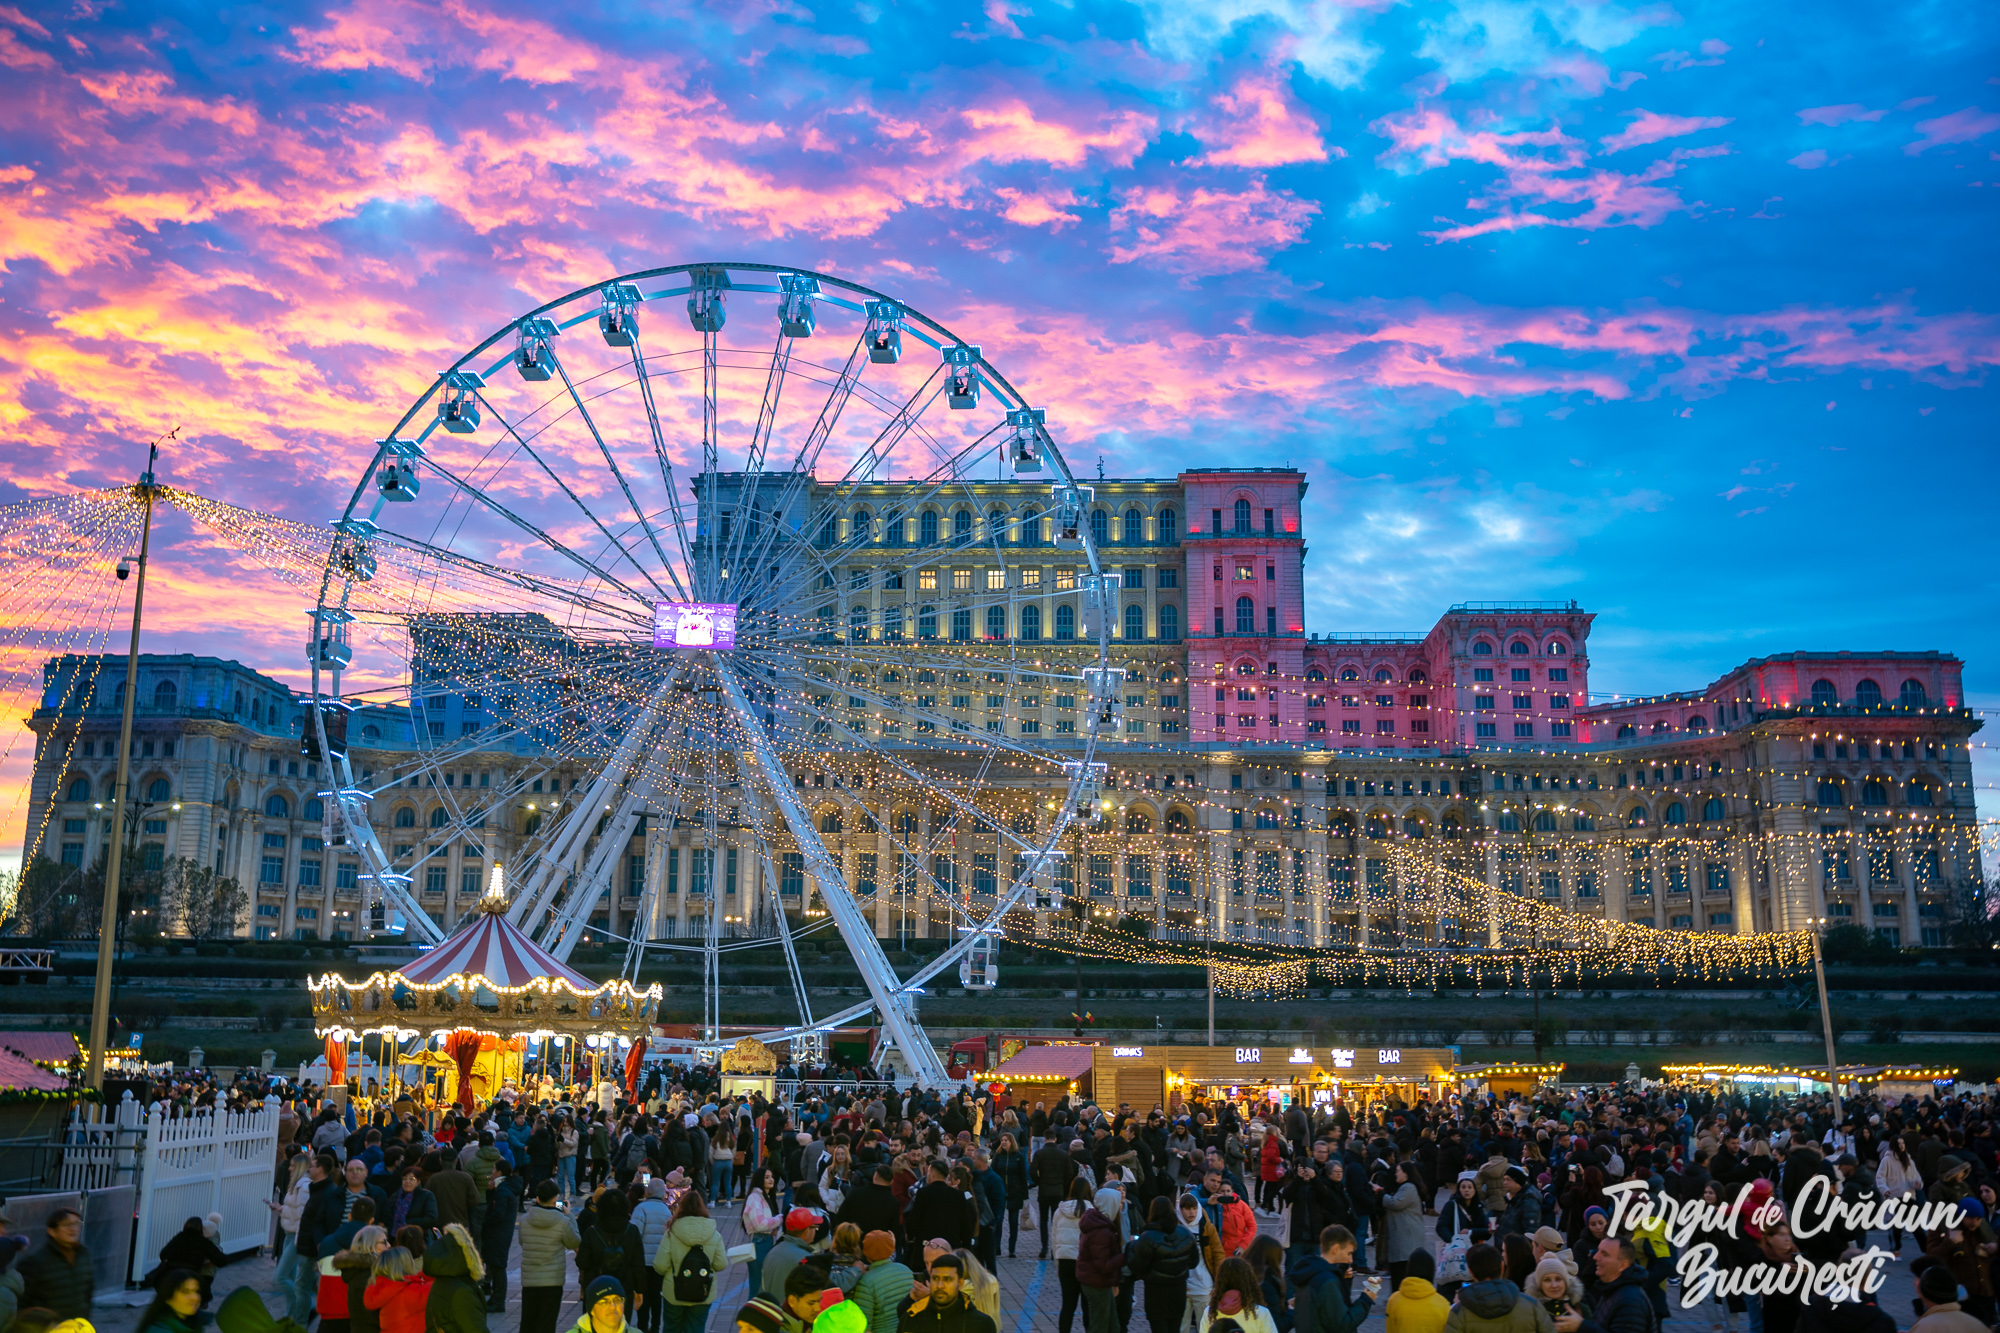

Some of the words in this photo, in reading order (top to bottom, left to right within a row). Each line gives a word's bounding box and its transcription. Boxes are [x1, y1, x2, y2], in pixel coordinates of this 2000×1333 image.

[1113, 1047, 1143, 1057] DRINKS
[1235, 1048, 1261, 1063] BAR
[1378, 1049, 1401, 1064] BAR
[1313, 1090, 1332, 1103] VIN
